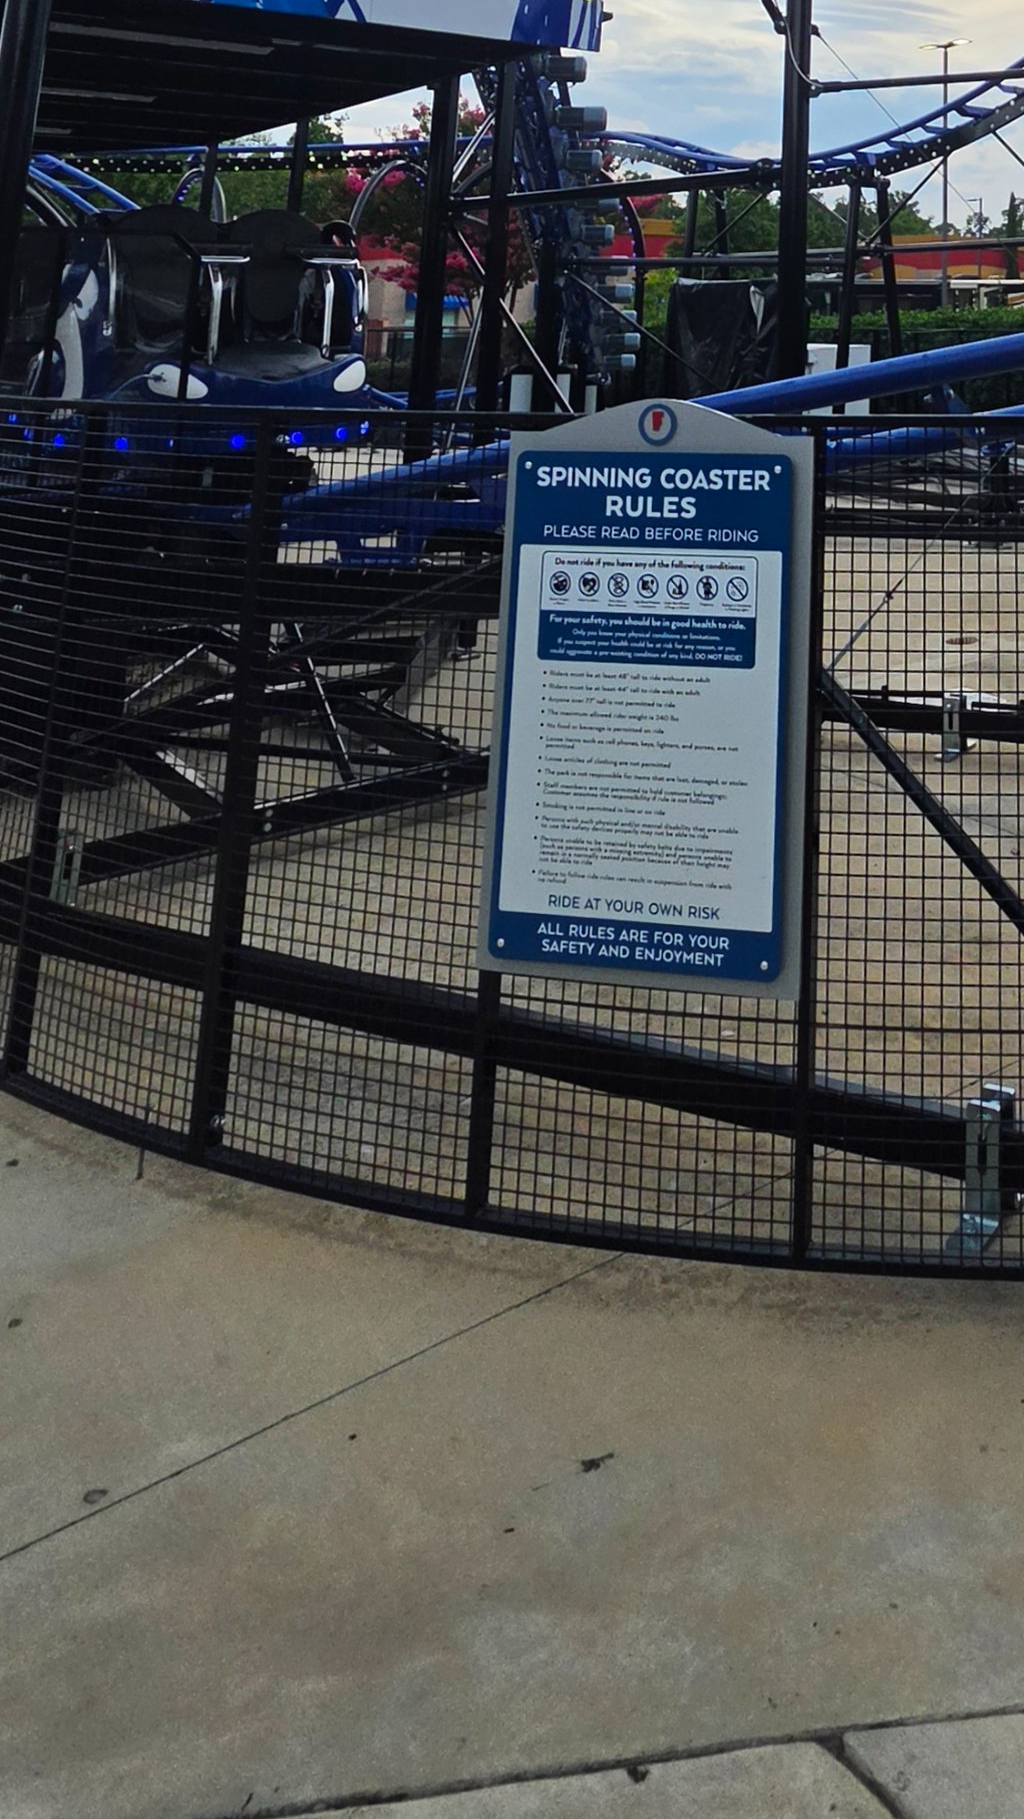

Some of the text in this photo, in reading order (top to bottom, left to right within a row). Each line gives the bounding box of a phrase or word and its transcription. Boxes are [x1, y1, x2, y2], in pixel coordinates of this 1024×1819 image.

[536, 466, 771, 491] SPINNING COASTER
[605, 495, 697, 519] RULES
[543, 524, 759, 543] PLEASE READ BEFORE RIDING
[555, 557, 566, 566] Do
[580, 557, 595, 567] ride
[595, 557, 601, 566] if
[602, 561, 615, 569] you
[616, 558, 634, 568] have
[634, 562, 647, 570] any
[648, 559, 657, 568] of
[657, 559, 670, 569] the
[671, 560, 705, 572] following
[549, 613, 746, 631] For your safety, you should be in good health to ride.
[694, 652, 707, 661] DO
[707, 653, 723, 661] NOT
[549, 894, 720, 921] RIDE AT YOUR OWN RISK
[537, 922, 730, 951] ALL RULES ARE FOR YOUR
[541, 938, 725, 967] SAFETY AND ENJOYMENT
